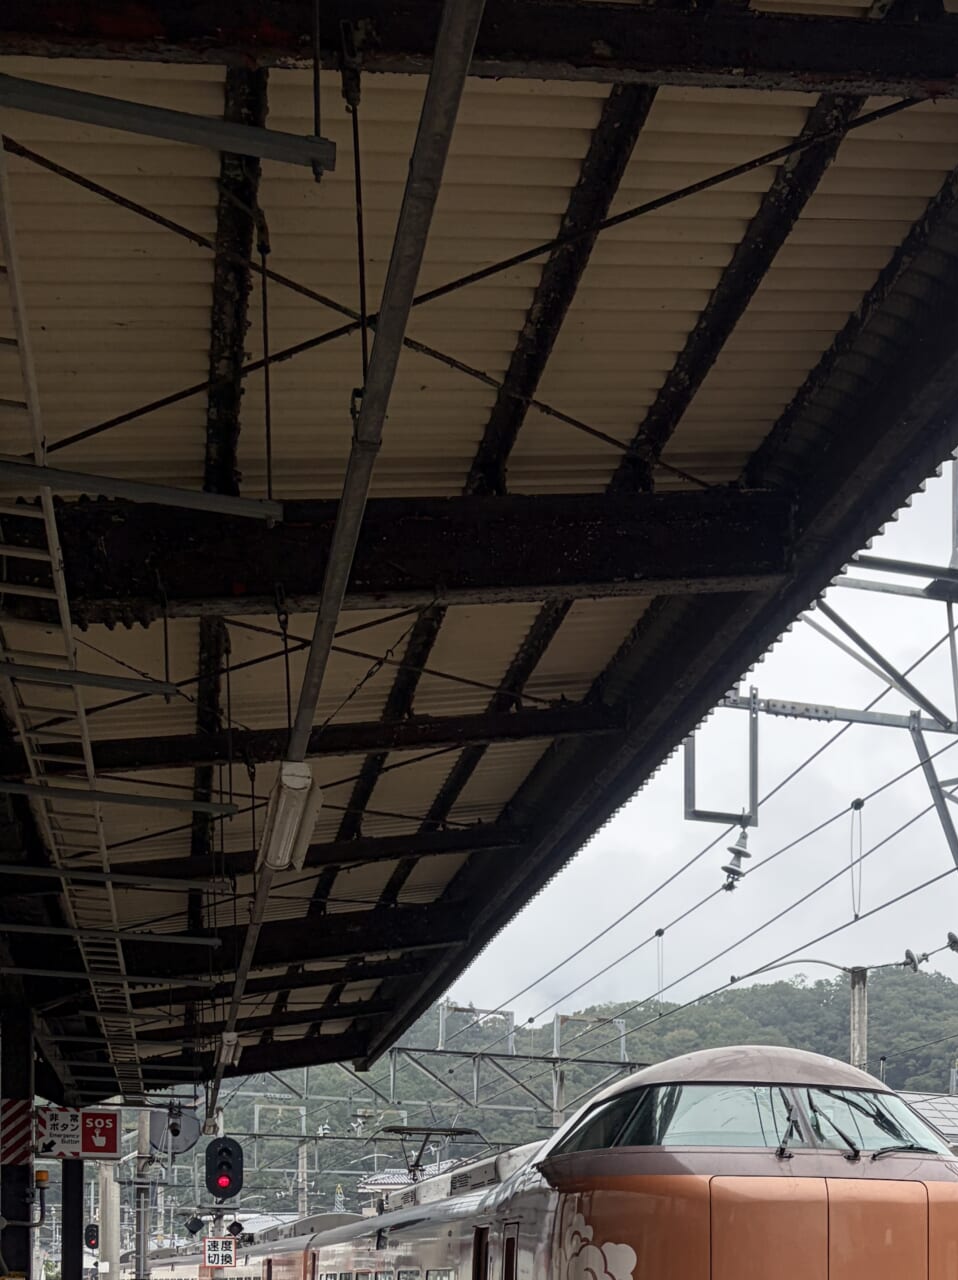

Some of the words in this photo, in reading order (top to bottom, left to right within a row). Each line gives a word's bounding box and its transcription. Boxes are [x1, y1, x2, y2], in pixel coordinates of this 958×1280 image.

[49, 1113, 79, 1122] 非常
[50, 1123, 79, 1132] ボタン
[86, 1118, 113, 1128] SOS
[207, 1240, 232, 1251] 速度
[207, 1253, 232, 1264] 切換
